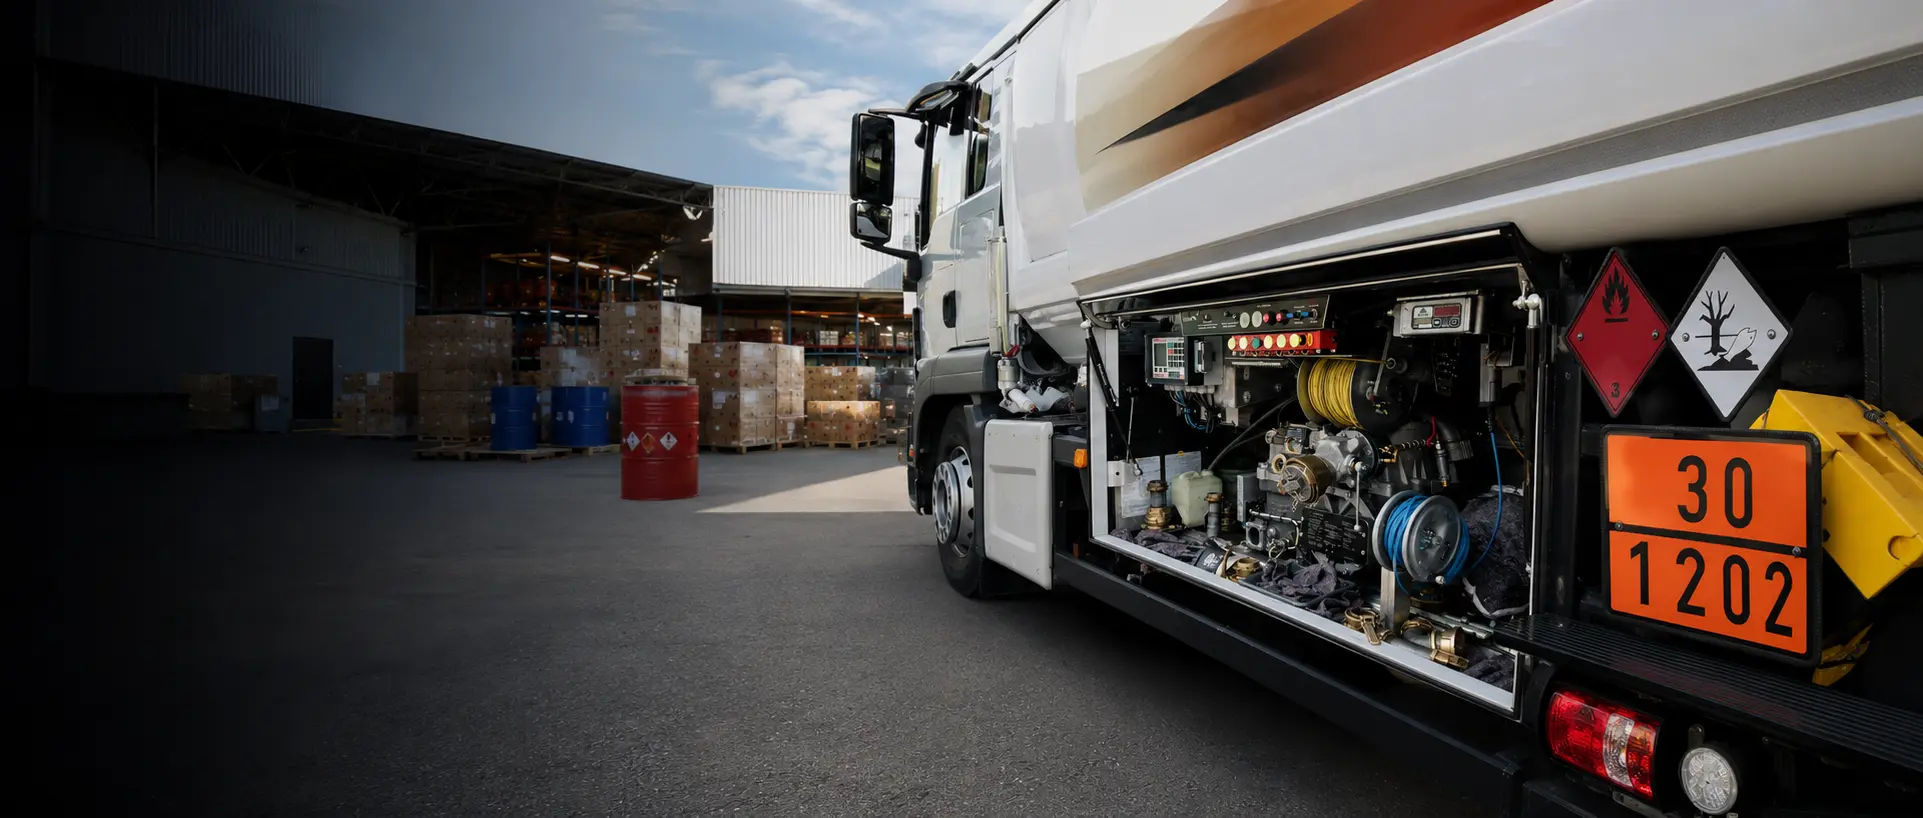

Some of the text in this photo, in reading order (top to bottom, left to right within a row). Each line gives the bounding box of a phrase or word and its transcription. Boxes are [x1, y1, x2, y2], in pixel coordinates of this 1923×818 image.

[1611, 382, 1620, 398] 3
[1677, 454, 1753, 529] 30
[1630, 541, 1793, 638] 1202
